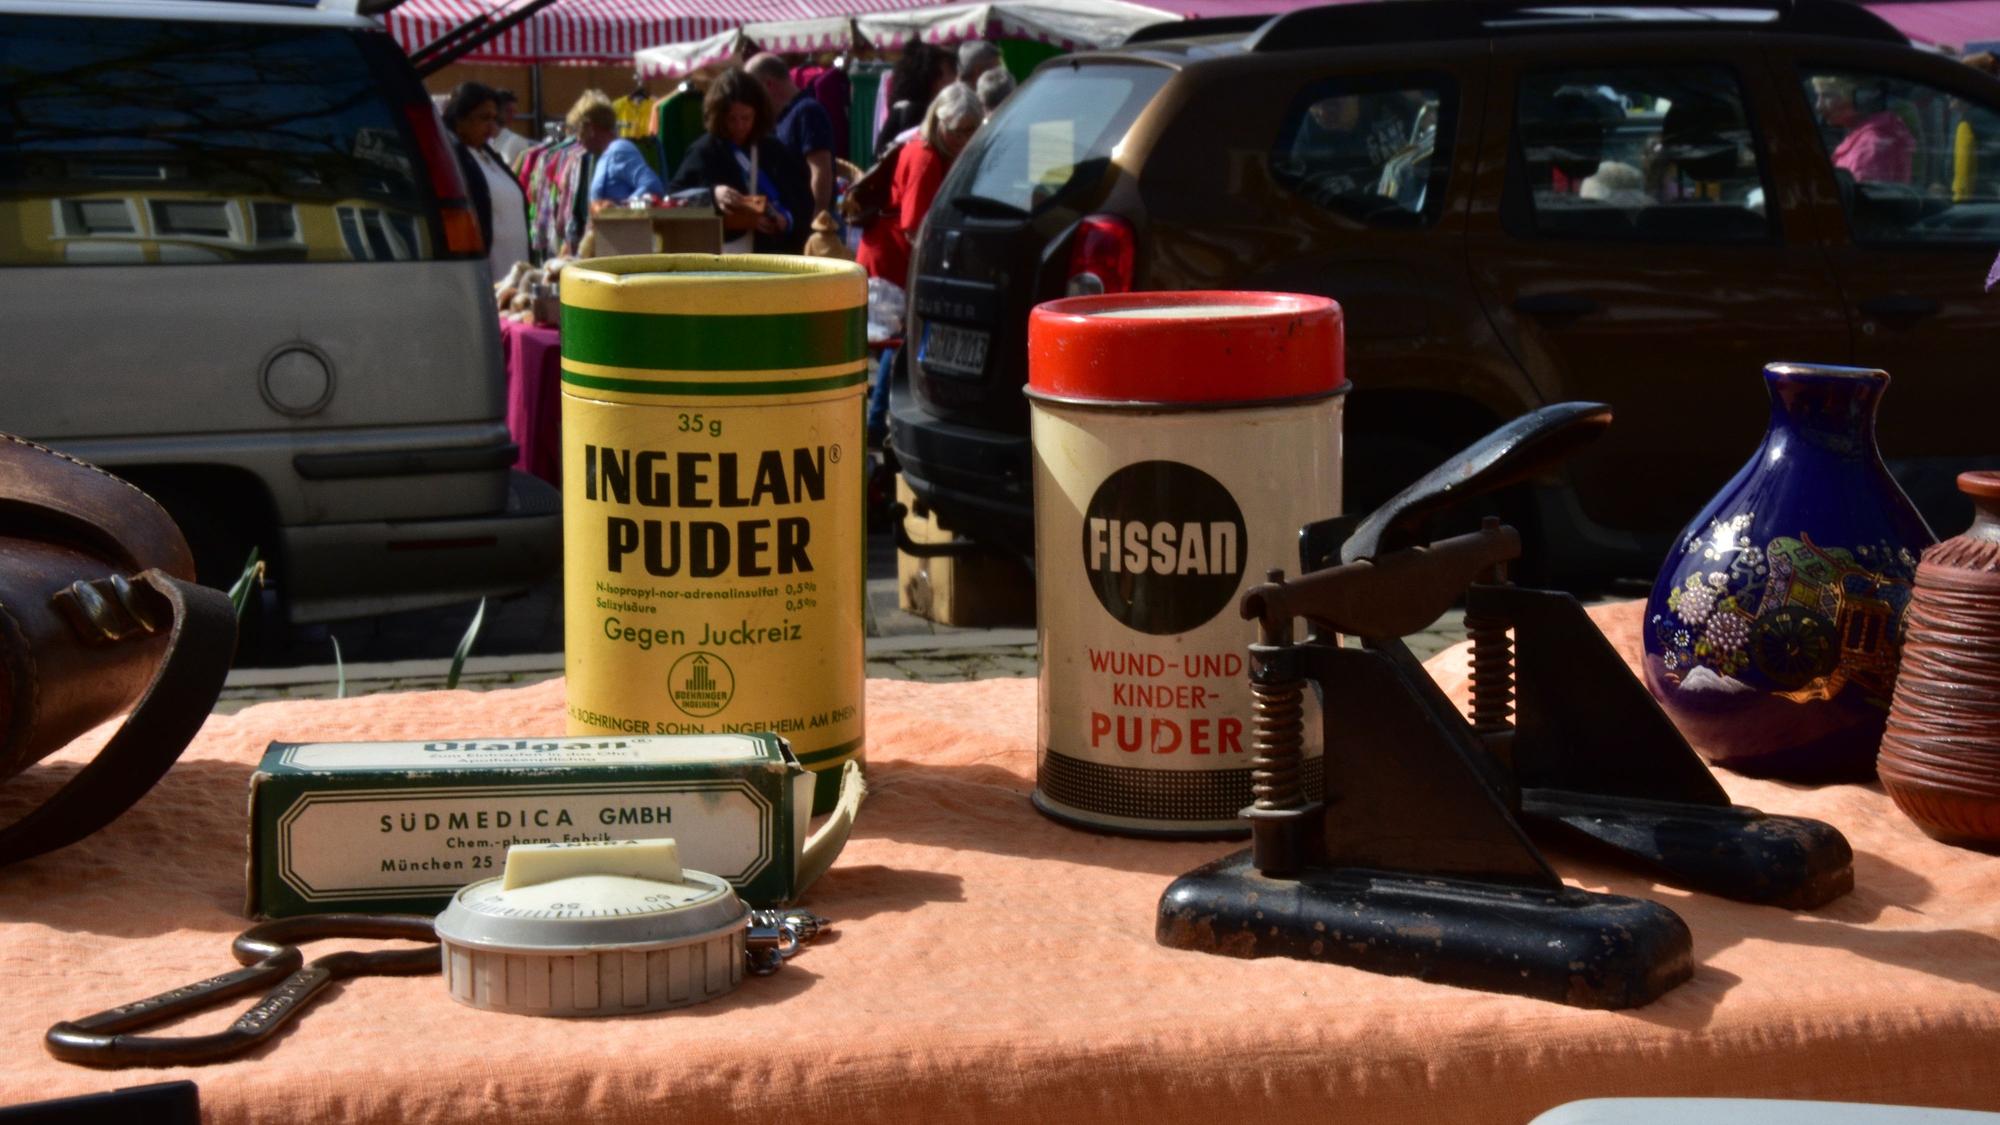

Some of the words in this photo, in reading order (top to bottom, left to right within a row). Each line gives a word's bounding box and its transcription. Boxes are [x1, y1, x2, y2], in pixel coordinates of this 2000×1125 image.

[677, 413, 704, 433] 35
[708, 418, 722, 437] g
[607, 516, 814, 578] PUDER
[1089, 517, 1237, 576] FISSAN
[596, 597, 657, 614] Salizylsäure
[604, 616, 685, 650] Gegen
[698, 618, 803, 646] Juckreiz
[674, 691, 728, 700] BOEHRINGER
[681, 701, 720, 709] INGELHEIM
[1113, 683, 1220, 710] KINDER-
[577, 708, 650, 735] BOEHRINGER
[656, 722, 706, 735] SOHN
[809, 712, 828, 729] AM
[1090, 711, 1245, 755] PUDER
[380, 808, 574, 833] SÜDMEDICA
[599, 806, 672, 825] GMBH
[563, 833, 611, 844] Fabrik
[381, 855, 463, 872] München
[471, 856, 493, 869] 25
